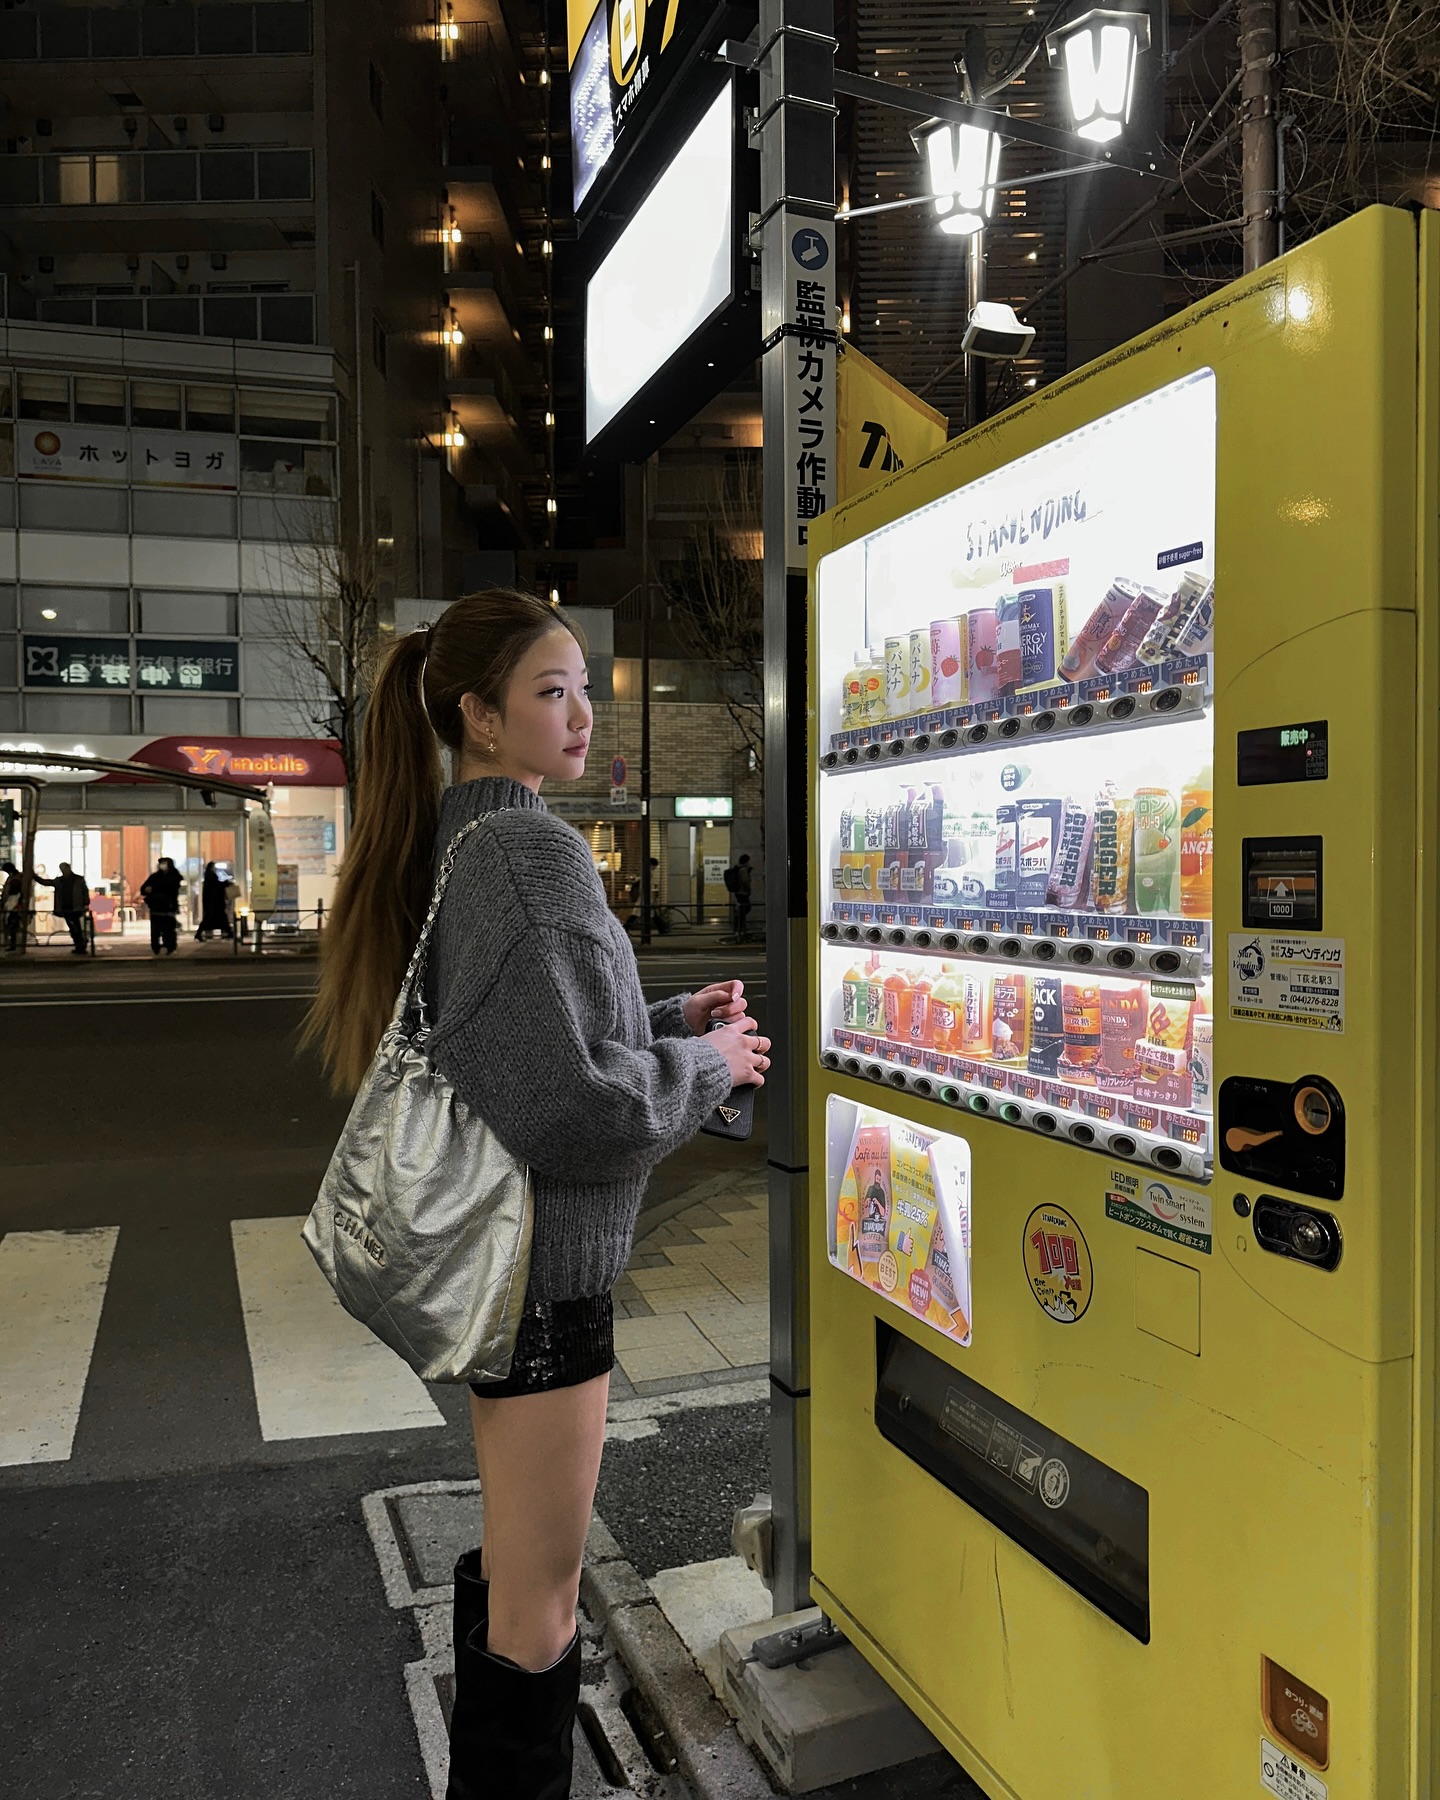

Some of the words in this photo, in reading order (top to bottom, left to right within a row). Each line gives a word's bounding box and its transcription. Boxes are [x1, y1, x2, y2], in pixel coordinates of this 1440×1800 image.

[79, 444, 226, 471] ホットヨガ
[911, 643, 922, 685] バナナ
[1167, 657, 1202, 670] つめたい
[891, 651, 903, 692] バナナ
[1123, 667, 1155, 679] つめたい
[1183, 672, 1198, 685] 100
[1083, 676, 1112, 688] つめたい
[1138, 682, 1152, 694] 100
[1281, 729, 1309, 746] 販売中
[1060, 813, 1087, 887] GINGER
[1099, 809, 1118, 897] GINGER
[1272, 904, 1291, 915] 1000
[1010, 912, 1035, 922] つめたい
[1043, 914, 1070, 924] つめたい
[1081, 916, 1111, 927] つめたい
[1120, 918, 1153, 929] つめたい
[1163, 920, 1199, 932] つめたい
[1137, 931, 1152, 944] 120
[1181, 934, 1198, 947] 120
[1232, 960, 1261, 973] Vending
[966, 984, 974, 1027] ミルクセーキ
[1290, 994, 1340, 1008] (044)276-8228
[1147, 1036, 1168, 1047] FIRE
[1045, 1082, 1072, 1096] あたたかい
[1136, 1087, 1179, 1102] 後味すっきり
[1082, 1091, 1112, 1106] あたたかい
[1097, 1107, 1110, 1119] 100
[1122, 1101, 1155, 1117] あたたかい
[1138, 1118, 1152, 1131] 100
[1166, 1112, 1200, 1128] あたたかい
[1183, 1129, 1198, 1142] 100
[854, 1145, 871, 1162] Café
[1111, 1170, 1139, 1190] LED照明
[1149, 1190, 1165, 1205] Twin
[1166, 1199, 1187, 1213] smart
[1180, 1213, 1206, 1229] system
[333, 1211, 386, 1267] CHANEL
[862, 1232, 882, 1242] COFFEE
[1030, 1226, 1080, 1277] 100
[880, 1263, 897, 1278] BEST
[911, 1281, 929, 1302] NEW!
